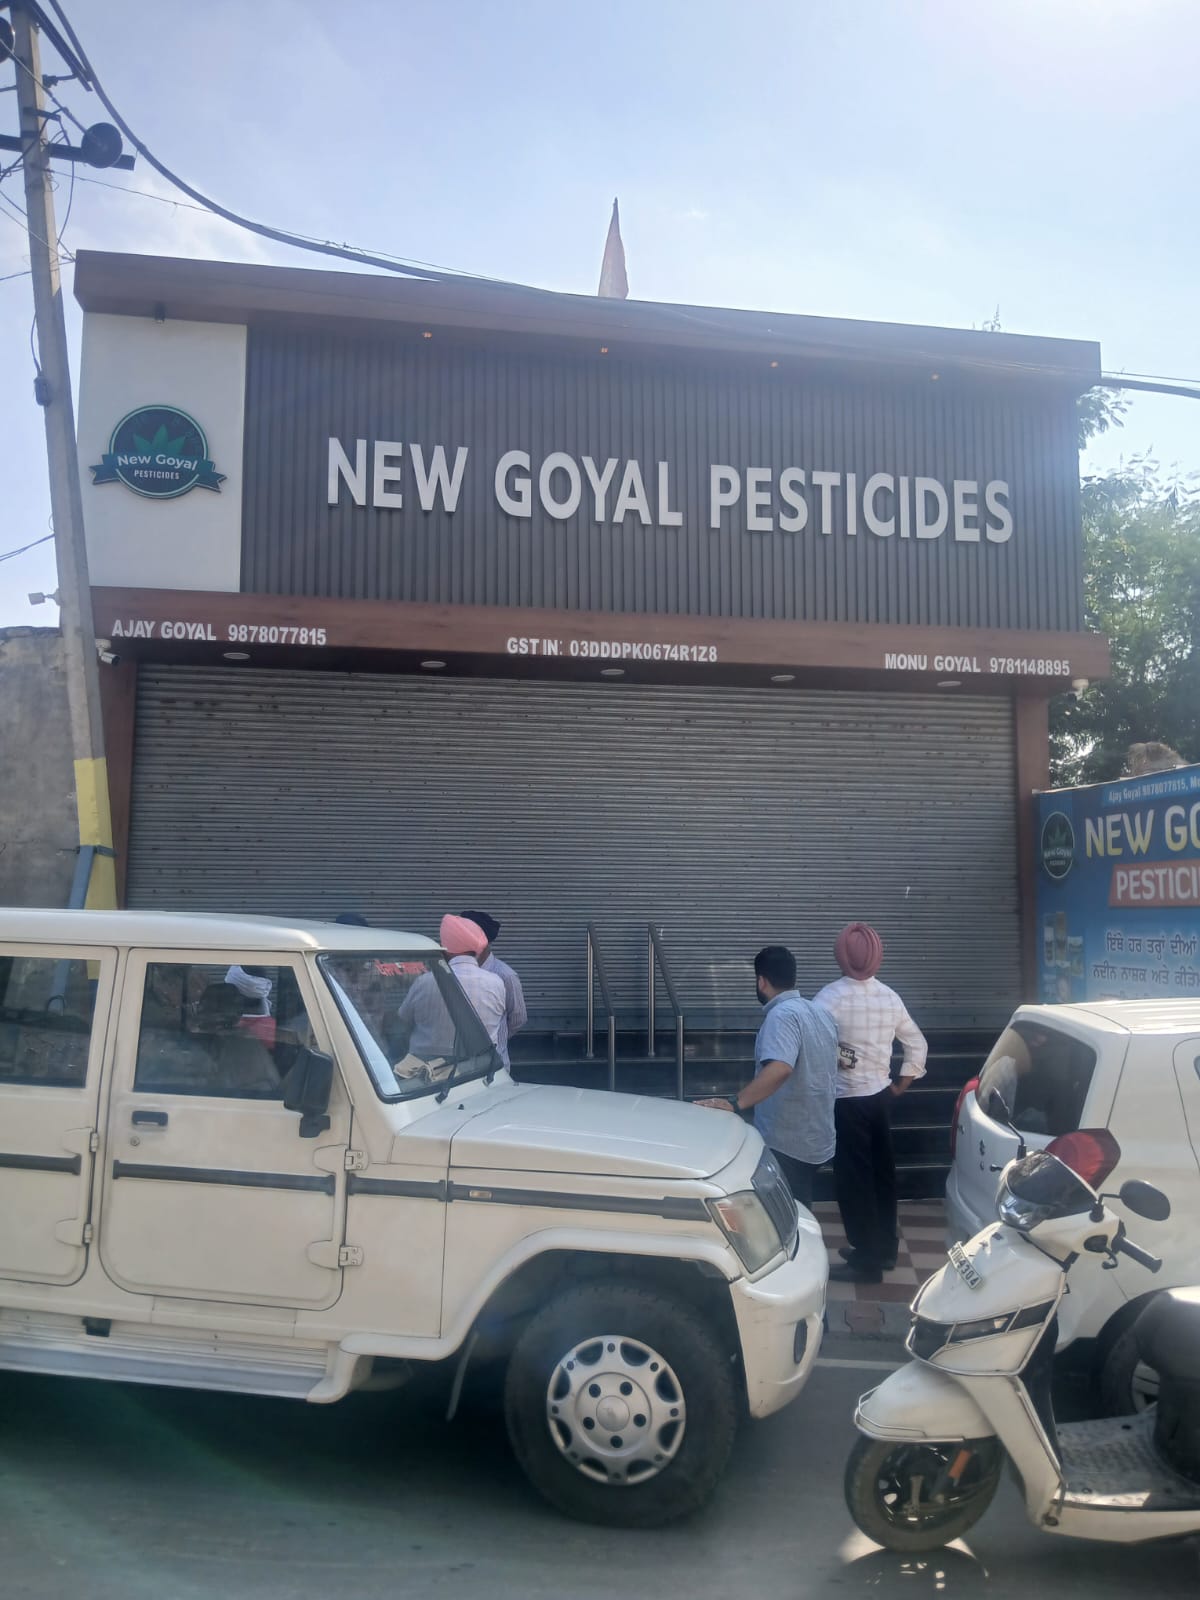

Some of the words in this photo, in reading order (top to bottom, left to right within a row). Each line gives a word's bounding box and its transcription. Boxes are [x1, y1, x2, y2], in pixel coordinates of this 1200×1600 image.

[117, 454, 152, 467] New
[155, 453, 199, 471] Goyal
[133, 469, 180, 480] PESTICIDES
[328, 436, 469, 513] NEW
[494, 449, 684, 527] GOYAL
[710, 463, 1014, 544] PESTICIDES
[111, 619, 156, 638] AJAY
[160, 621, 217, 641] GOYAL
[228, 624, 327, 646] 9878077815
[507, 637, 540, 656] GST
[569, 639, 718, 662] 03DDDPK0674R1Z8
[885, 653, 928, 671] MONU
[934, 655, 981, 673] GOYAL
[989, 657, 1071, 677] 9781148895
[1085, 809, 1155, 858] NEW
[1116, 866, 1200, 901] PESTICI
[1128, 938, 1142, 953] ਹਰ
